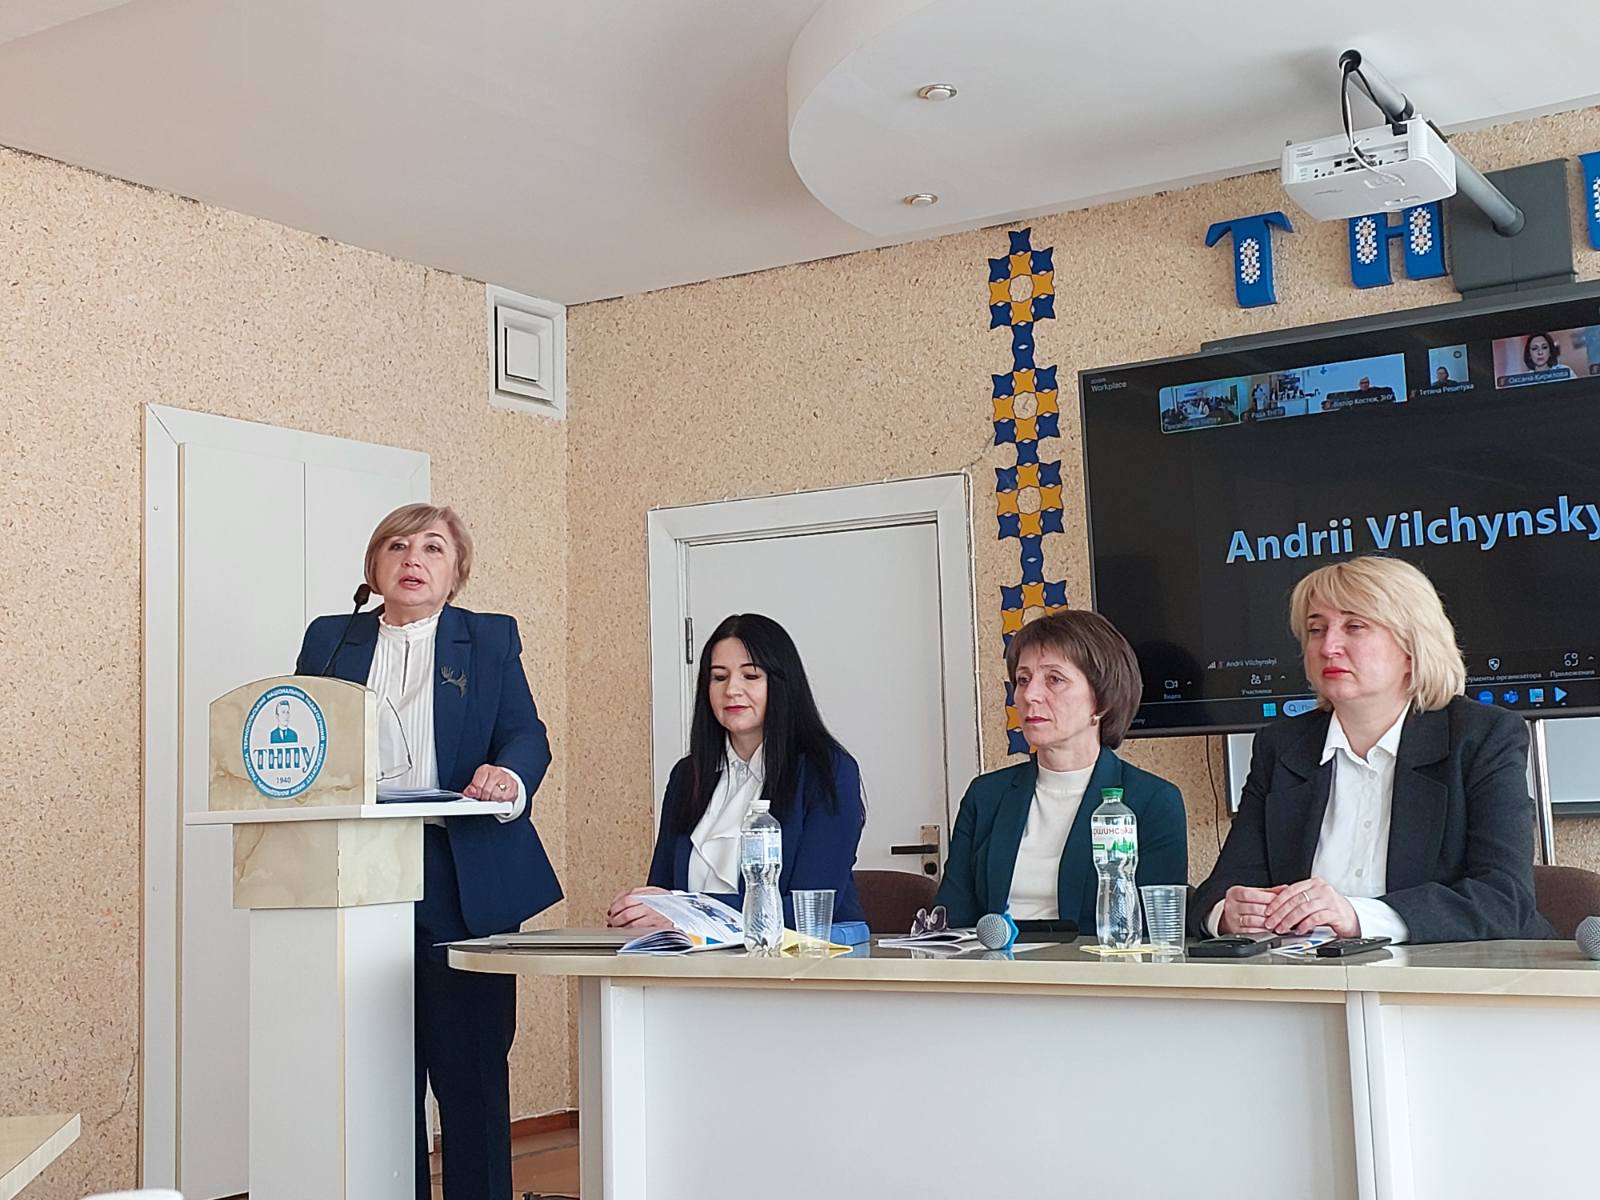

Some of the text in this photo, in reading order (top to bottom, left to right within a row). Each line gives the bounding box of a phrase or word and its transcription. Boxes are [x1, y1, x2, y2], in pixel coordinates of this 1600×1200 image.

[1091, 381, 1127, 393] Workplace
[1225, 495, 1600, 564] Andrii Vilchynsky
[253, 746, 315, 773] ТНПУ
[276, 776, 292, 784] 1940
